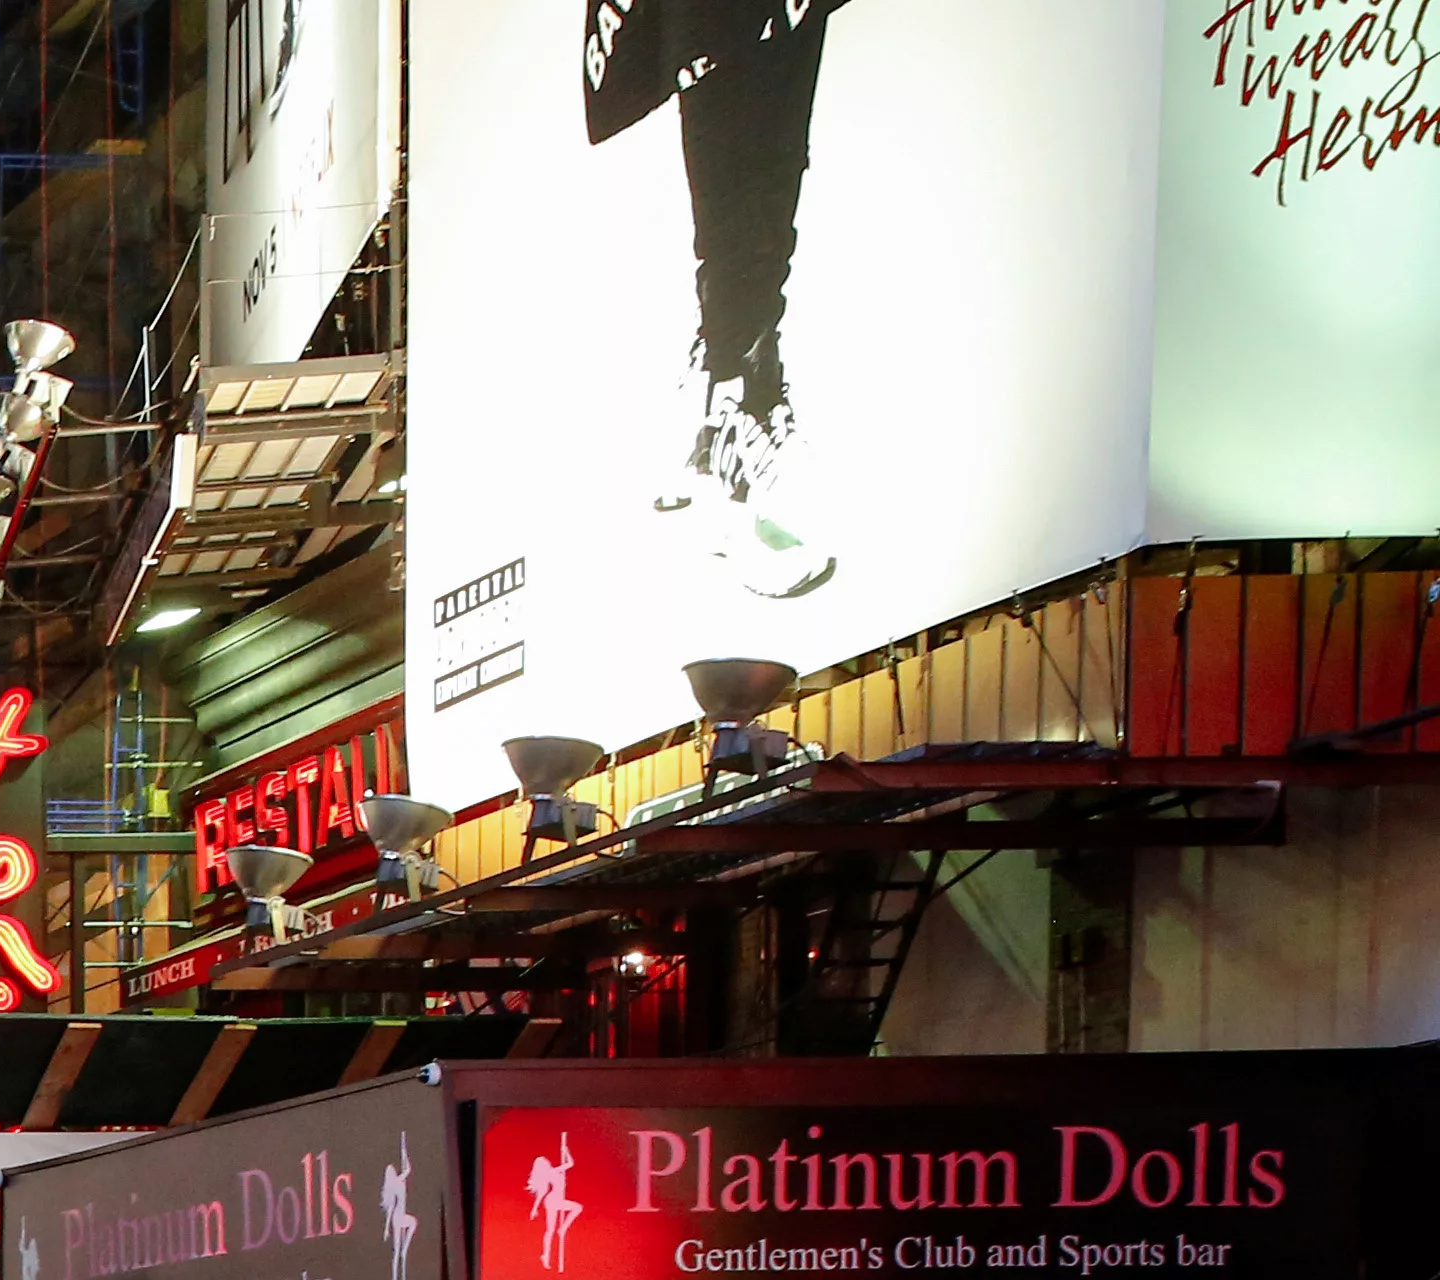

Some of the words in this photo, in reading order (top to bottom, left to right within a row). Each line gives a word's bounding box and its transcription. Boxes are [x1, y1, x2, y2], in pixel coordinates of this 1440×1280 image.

[128, 957, 195, 997] LUNCH
[627, 1125, 1022, 1213] Platinum
[1052, 1122, 1286, 1209] Dolls
[236, 1149, 355, 1252] Dolls
[674, 1237, 884, 1273] Gentlemen's
[894, 1236, 976, 1270] Club
[987, 1236, 1047, 1269] and
[1059, 1236, 1165, 1276] Sports
[1177, 1236, 1232, 1268] bar
